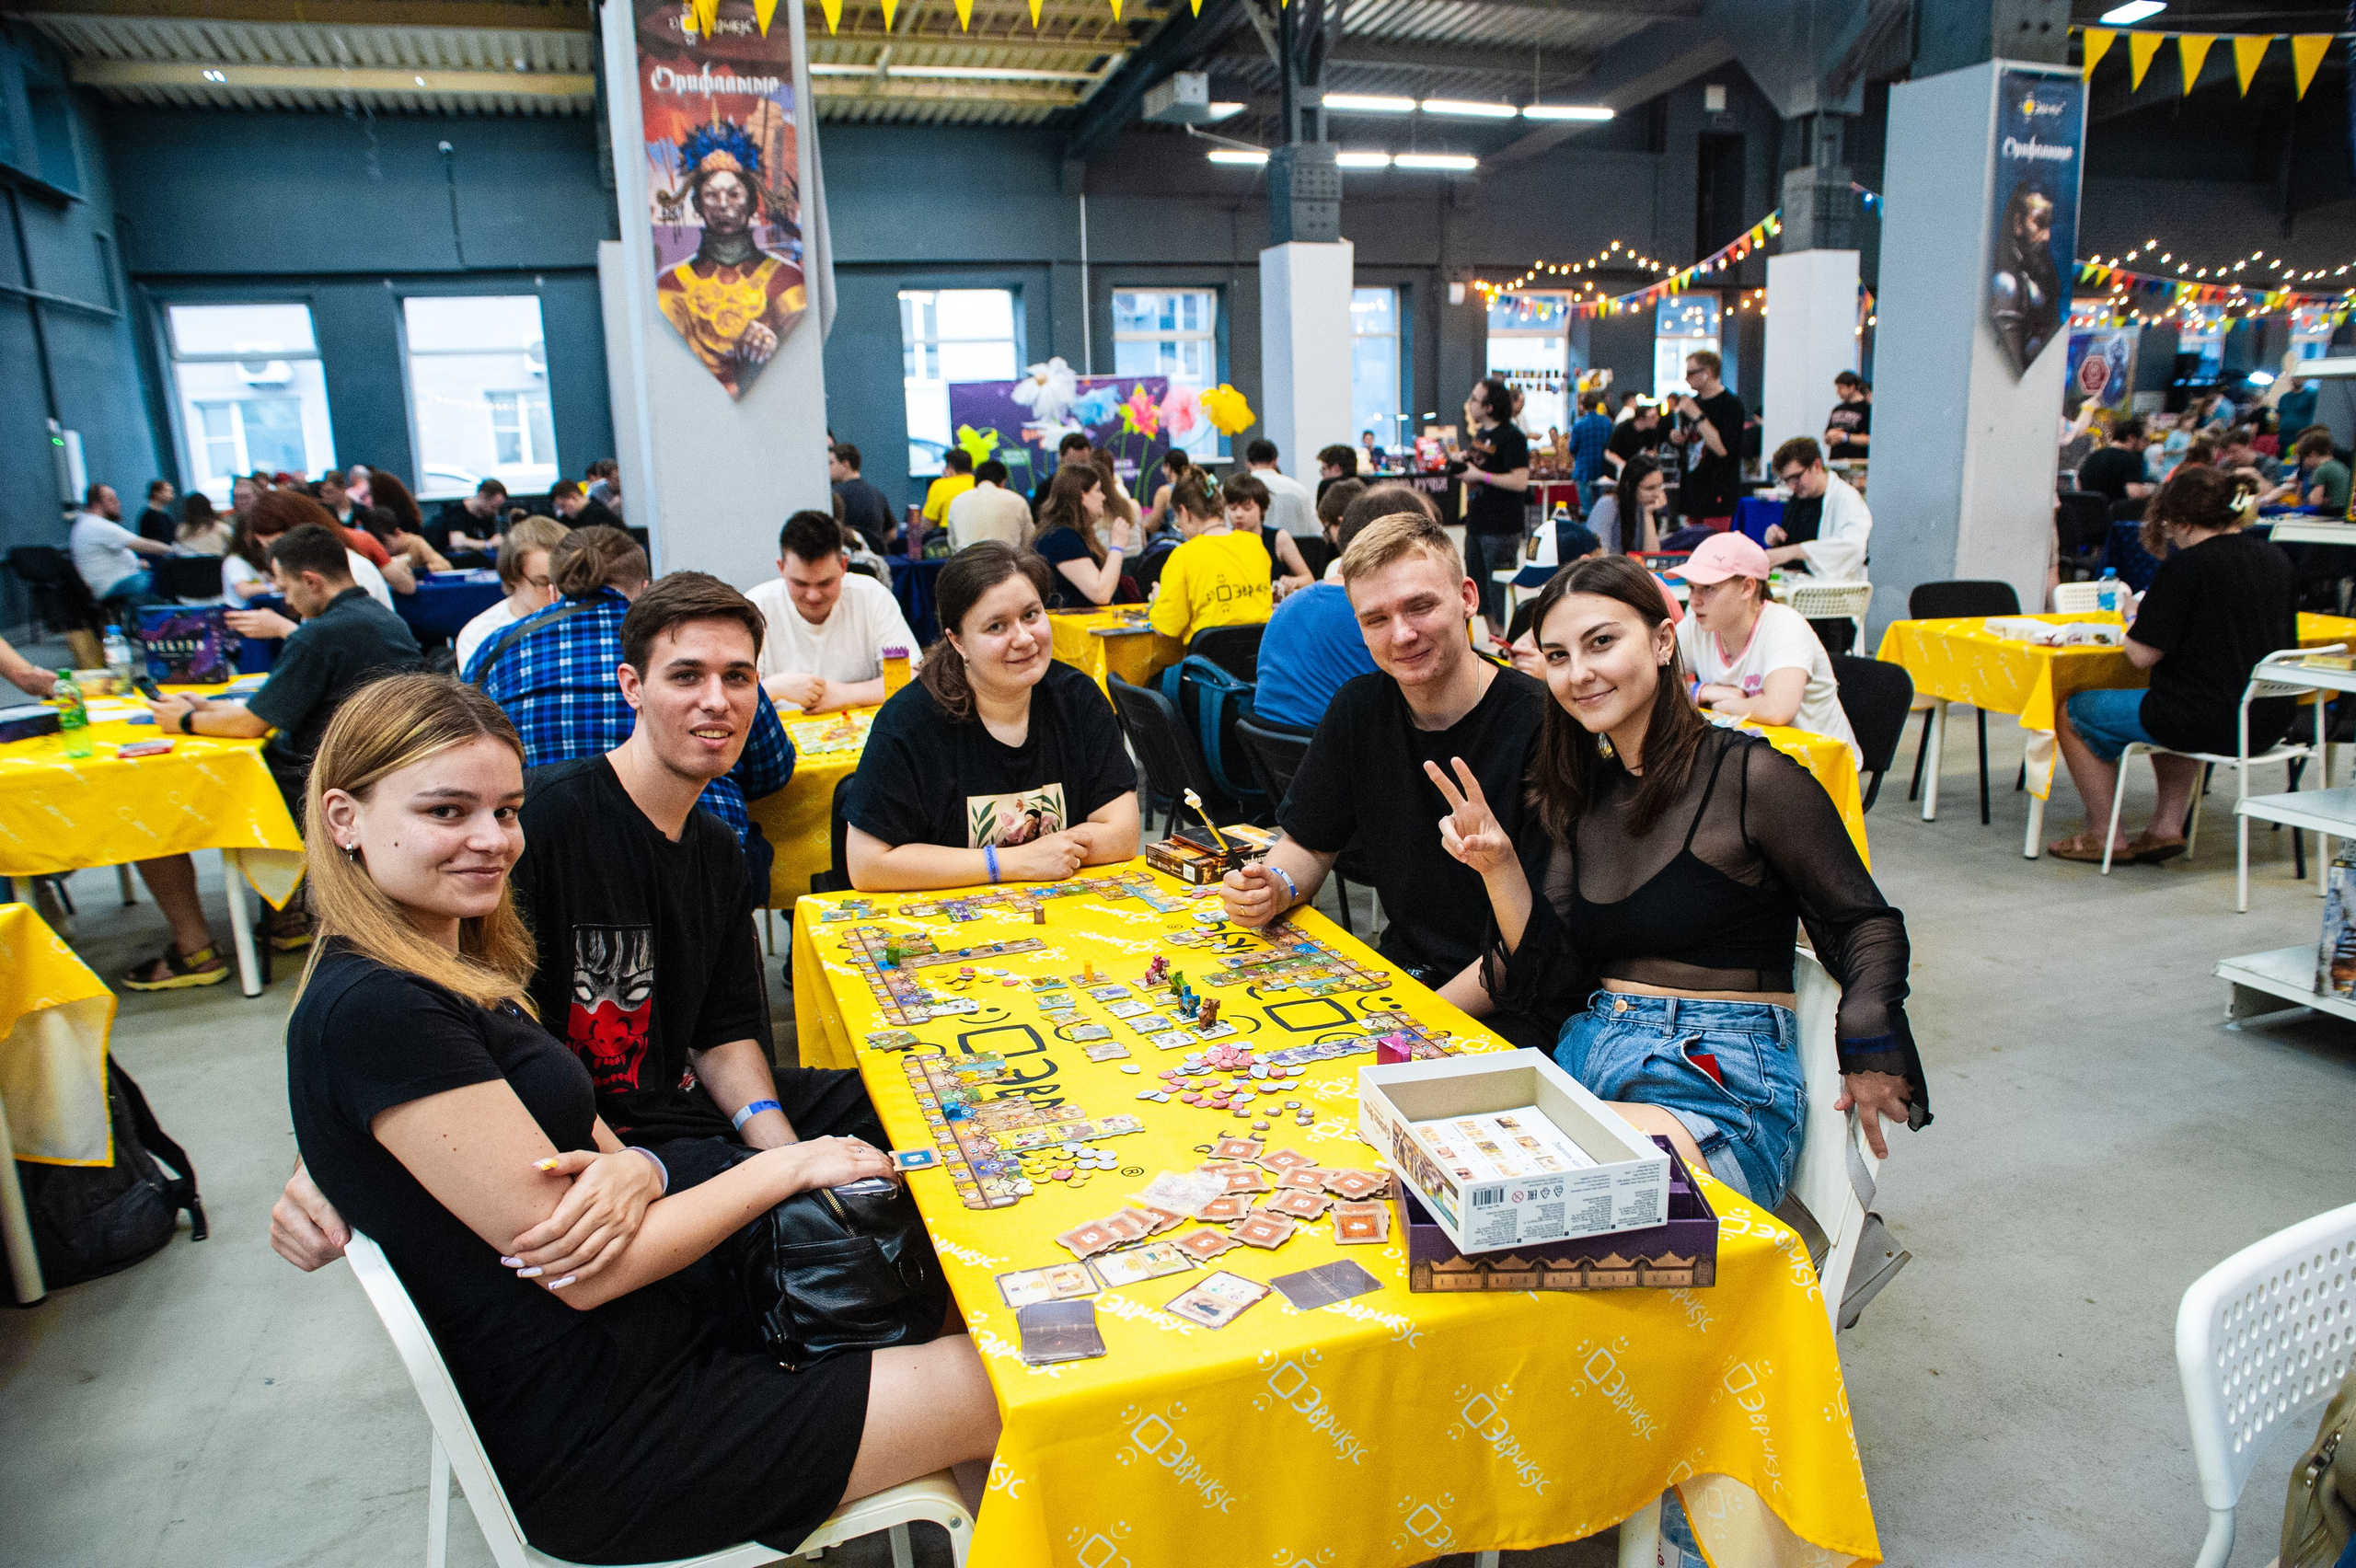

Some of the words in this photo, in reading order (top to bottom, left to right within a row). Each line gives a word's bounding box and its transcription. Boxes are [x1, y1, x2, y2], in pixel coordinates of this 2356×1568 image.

[1229, 1145, 1245, 1154] 16
[1292, 1197, 1311, 1207] 10
[1080, 1231, 1099, 1244] 10
[1196, 1239, 1215, 1247] 5
[1349, 1222, 1368, 1230] 4
[1291, 1385, 1369, 1466] Эврикус
[1602, 1370, 1658, 1442] Эврикус
[1481, 1416, 1553, 1496] Эврикус
[1738, 1389, 1784, 1495] Эврикус
[1158, 1437, 1238, 1515] Эврикус
